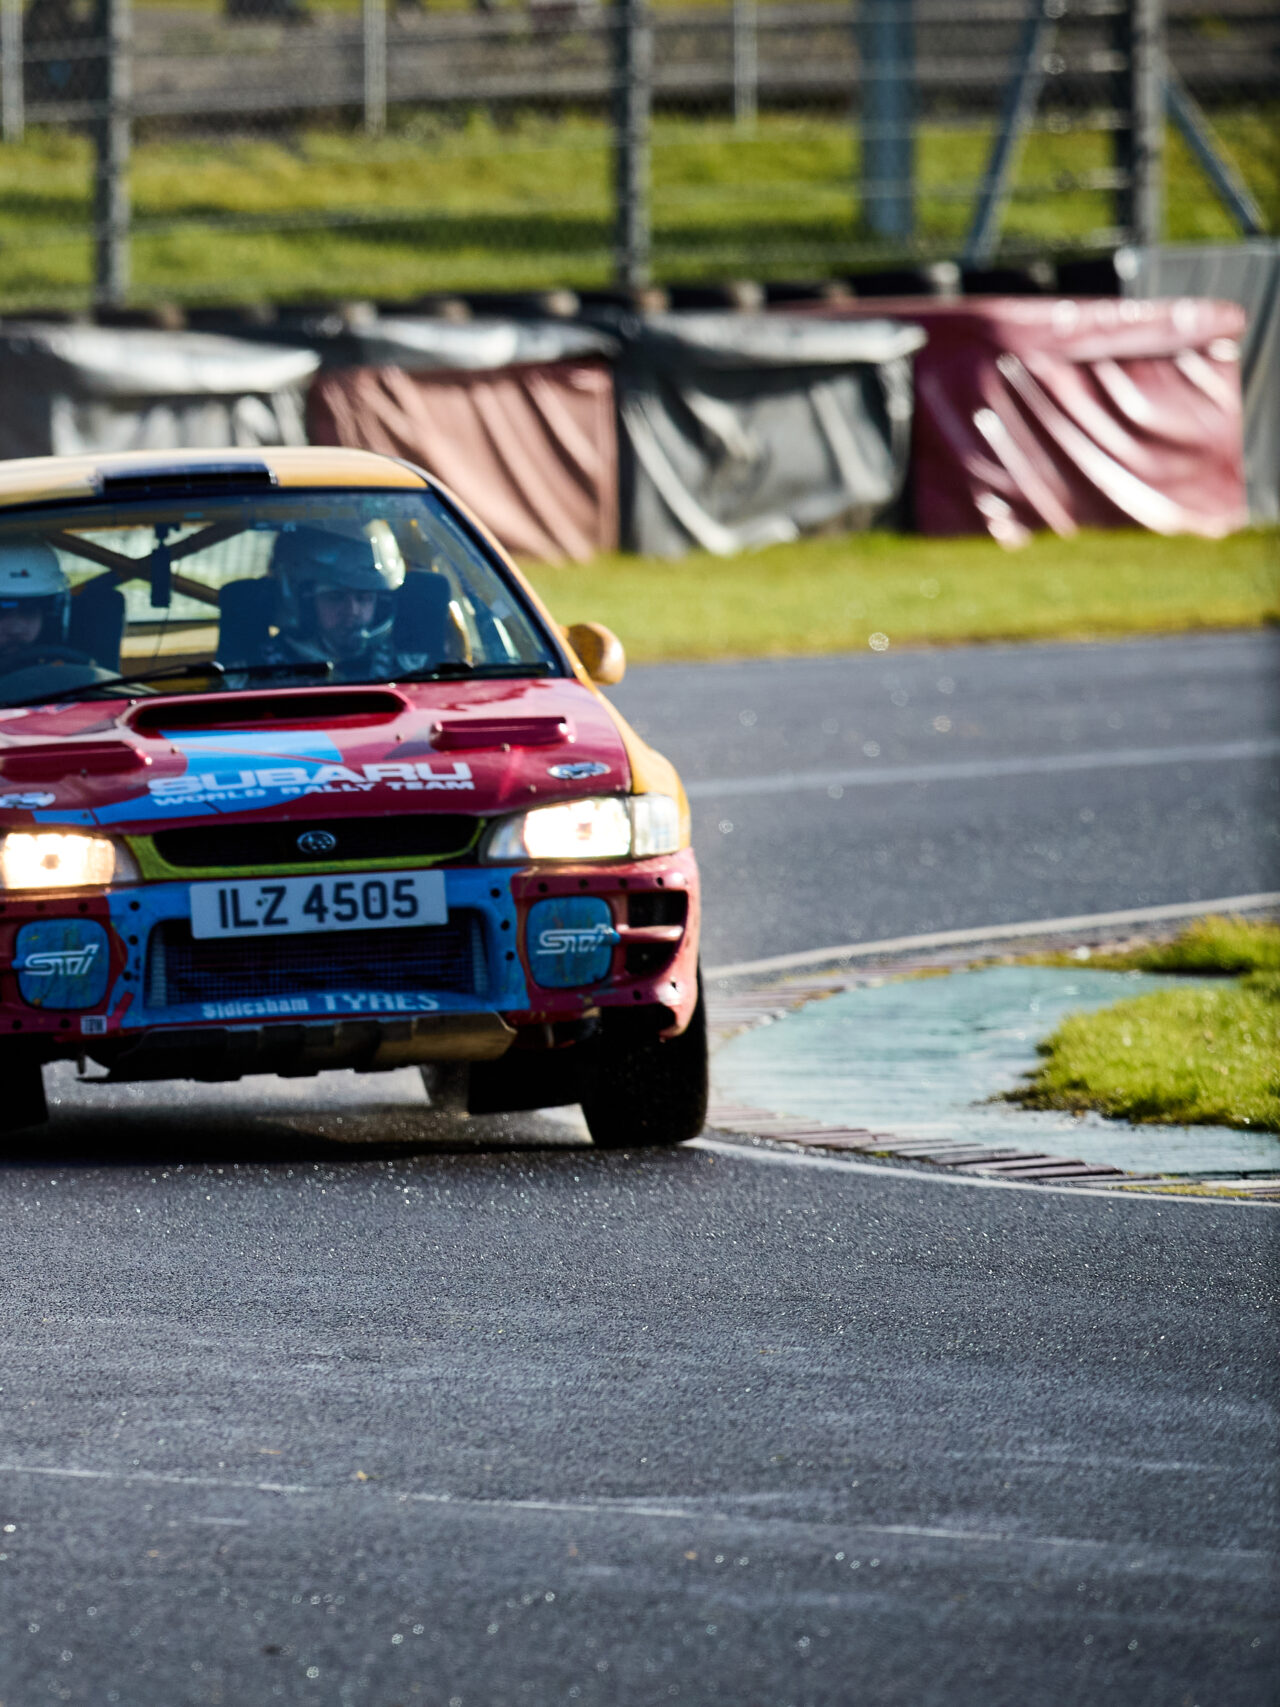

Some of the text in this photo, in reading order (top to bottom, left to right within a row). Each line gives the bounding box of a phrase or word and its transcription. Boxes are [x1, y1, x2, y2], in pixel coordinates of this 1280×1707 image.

[147, 762, 473, 796] SUBARU
[152, 780, 475, 807] WORLD RALLY TEAM
[218, 878, 419, 929] ILZ 4505
[318, 992, 440, 1012] TYRES
